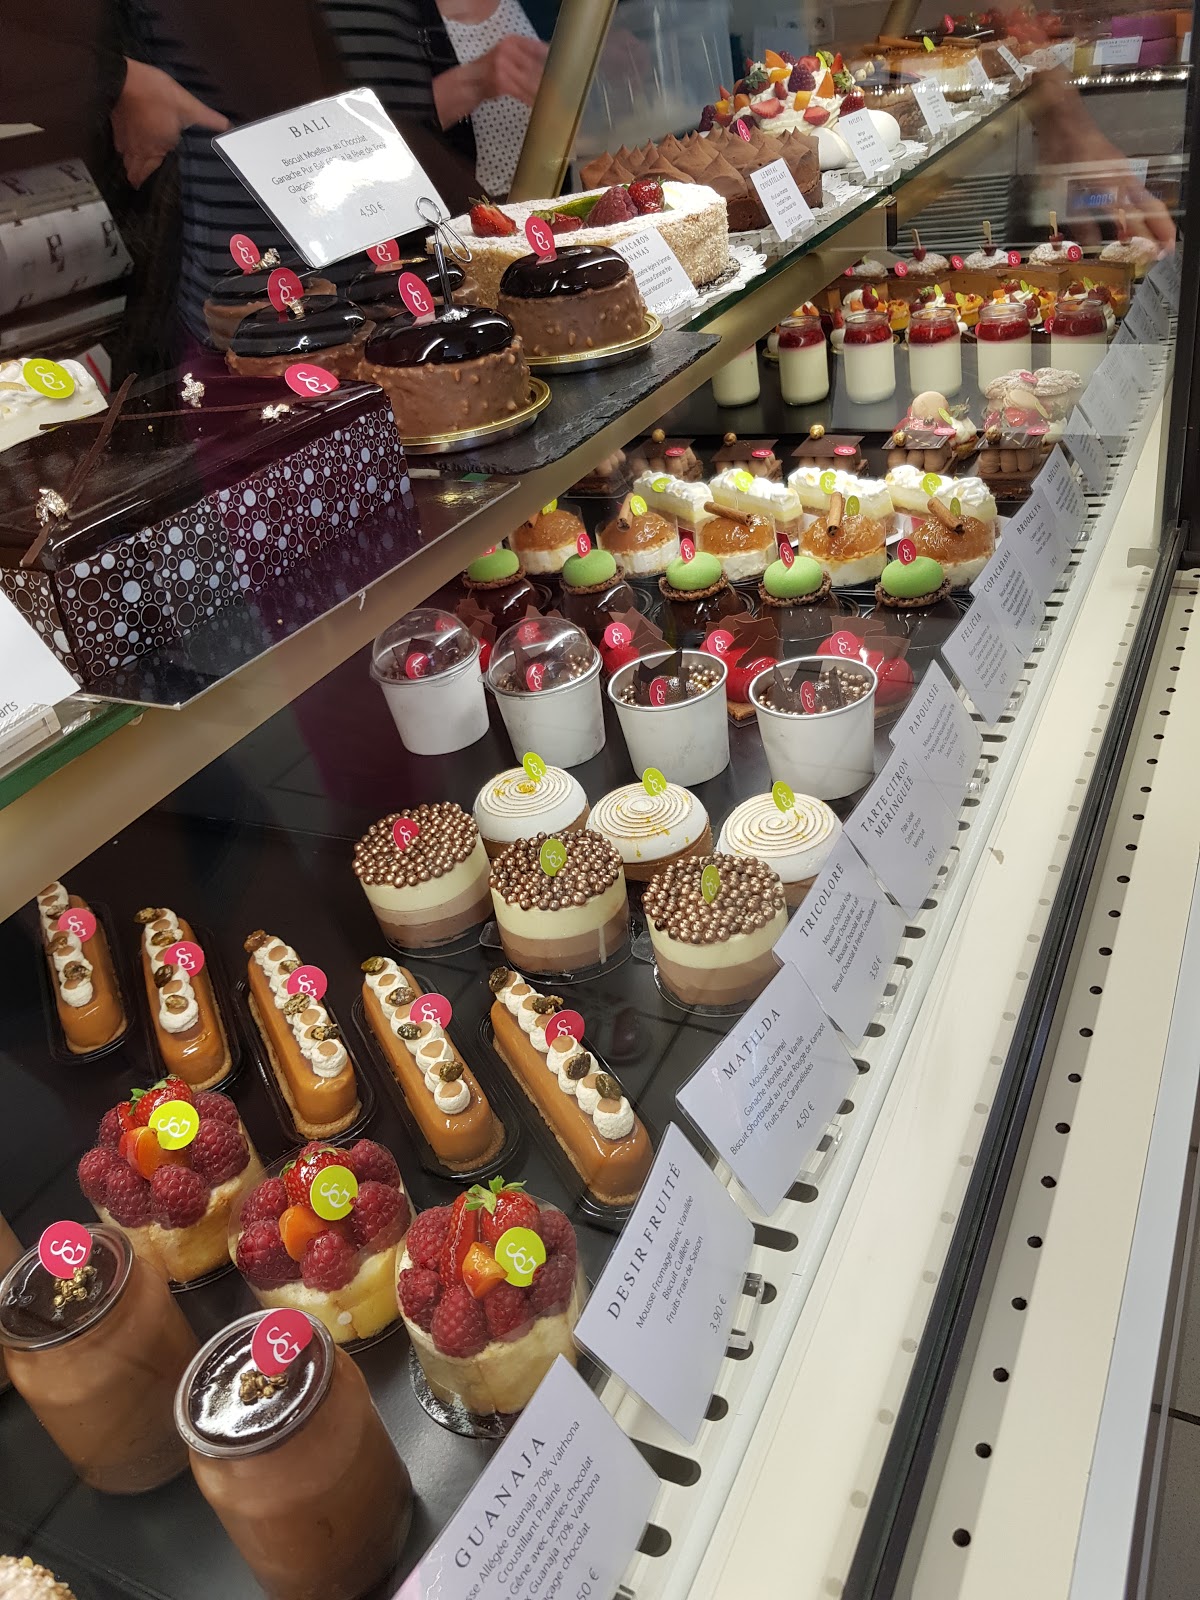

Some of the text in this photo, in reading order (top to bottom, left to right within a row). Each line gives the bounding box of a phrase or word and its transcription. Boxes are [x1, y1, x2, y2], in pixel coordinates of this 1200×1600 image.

[281, 154, 305, 167] Biscuit
[303, 146, 332, 160] Moelleux
[332, 143, 342, 151] au
[340, 134, 369, 148] Chocolat
[288, 116, 331, 138] BALI
[272, 170, 303, 185] Ganache
[301, 165, 314, 175] Pur
[360, 201, 386, 218] 4,50 €
[619, 233, 650, 254] MACARON
[1016, 503, 1042, 535] BROOKLYN
[983, 549, 1012, 593] COPACABANA
[960, 612, 982, 643] FELICIA
[908, 683, 940, 735] PAPOUASIE
[860, 758, 910, 833] TARTE CITRON
[874, 776, 914, 839] MERINGUÉE
[799, 863, 845, 938] TRICOLORE
[822, 892, 852, 945] Mousse Chocolat Noir
[827, 935, 842, 957] Mousse
[838, 913, 852, 937] Chocolat
[849, 907, 856, 916] au
[835, 907, 865, 964] Mousse Chocolat Blanc
[831, 973, 845, 993] Biscuit
[841, 949, 856, 975] Chocolat
[855, 930, 865, 947] Perles
[869, 954, 882, 980] 3,50 €
[721, 1008, 782, 1080] MATILDA
[748, 1038, 788, 1089] Mousse Caramel
[729, 1022, 826, 1156] Biscuit Shortbread au Poivre Rouge de Kampot
[743, 1035, 805, 1117] Ganache Montée à la Vanille
[764, 1061, 814, 1132] Fruits secs Caramélisées
[795, 1100, 816, 1130] 4,50 €
[606, 1161, 682, 1321] DESIR FRUITÉ
[635, 1195, 694, 1329] Mousse Fromage Blanc Vanillée
[661, 1238, 691, 1301] Biscuit Cuillère
[665, 1235, 704, 1324] Fruits Frais de Saison
[709, 1293, 727, 1334] 3,90 €
[454, 1437, 547, 1569] GUANAJA
[478, 1539, 509, 1584] Allégée
[505, 1490, 539, 1538] Guanaja
[533, 1467, 553, 1498] 70%
[549, 1419, 581, 1467] Valrhona
[509, 1455, 595, 1596] Gêne avec perles chocolat
[497, 1482, 562, 1584] Croustillant Praliné
[529, 1547, 560, 1595] Guanaja
[555, 1521, 574, 1547] 70%
[571, 1472, 602, 1519] Valrhona
[562, 1522, 591, 1570] chocolat
[588, 1567, 600, 1581] €
